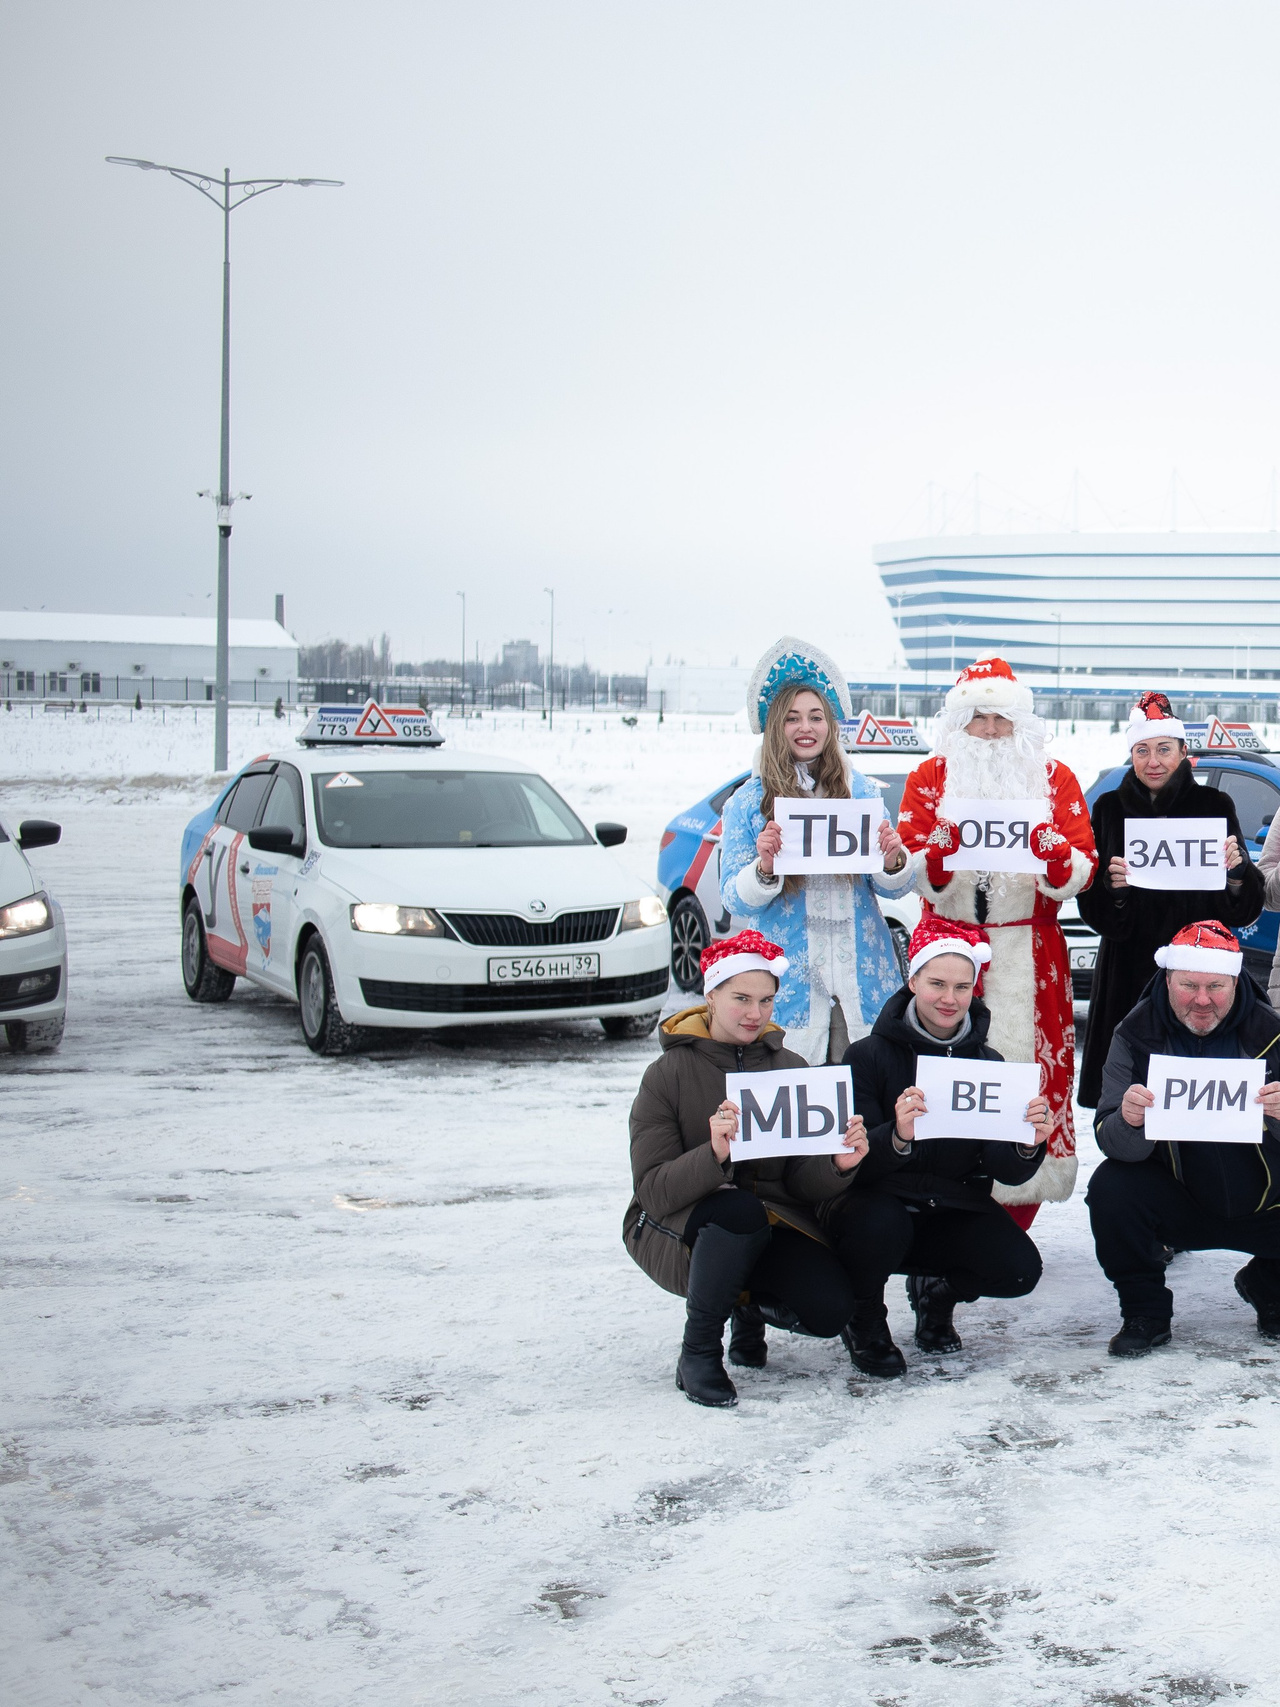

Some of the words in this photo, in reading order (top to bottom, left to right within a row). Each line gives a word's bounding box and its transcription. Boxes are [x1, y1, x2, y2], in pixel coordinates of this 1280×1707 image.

[317, 714, 358, 725] Экстерн
[368, 718, 381, 733] У
[317, 724, 348, 736] 773
[403, 725, 432, 737] 055
[866, 728, 877, 743] У
[893, 735, 919, 746] 055
[1215, 732, 1224, 745] У
[1238, 738, 1260, 748] 055
[789, 814, 871, 858] ТЫ
[958, 819, 1030, 849] ОБЯ
[1128, 839, 1219, 868] ЗАТЕ
[576, 956, 592, 970] 39
[951, 1080, 1001, 1113] ВЕ
[1163, 1078, 1248, 1112] РИМ
[740, 1081, 847, 1142] МЫ
